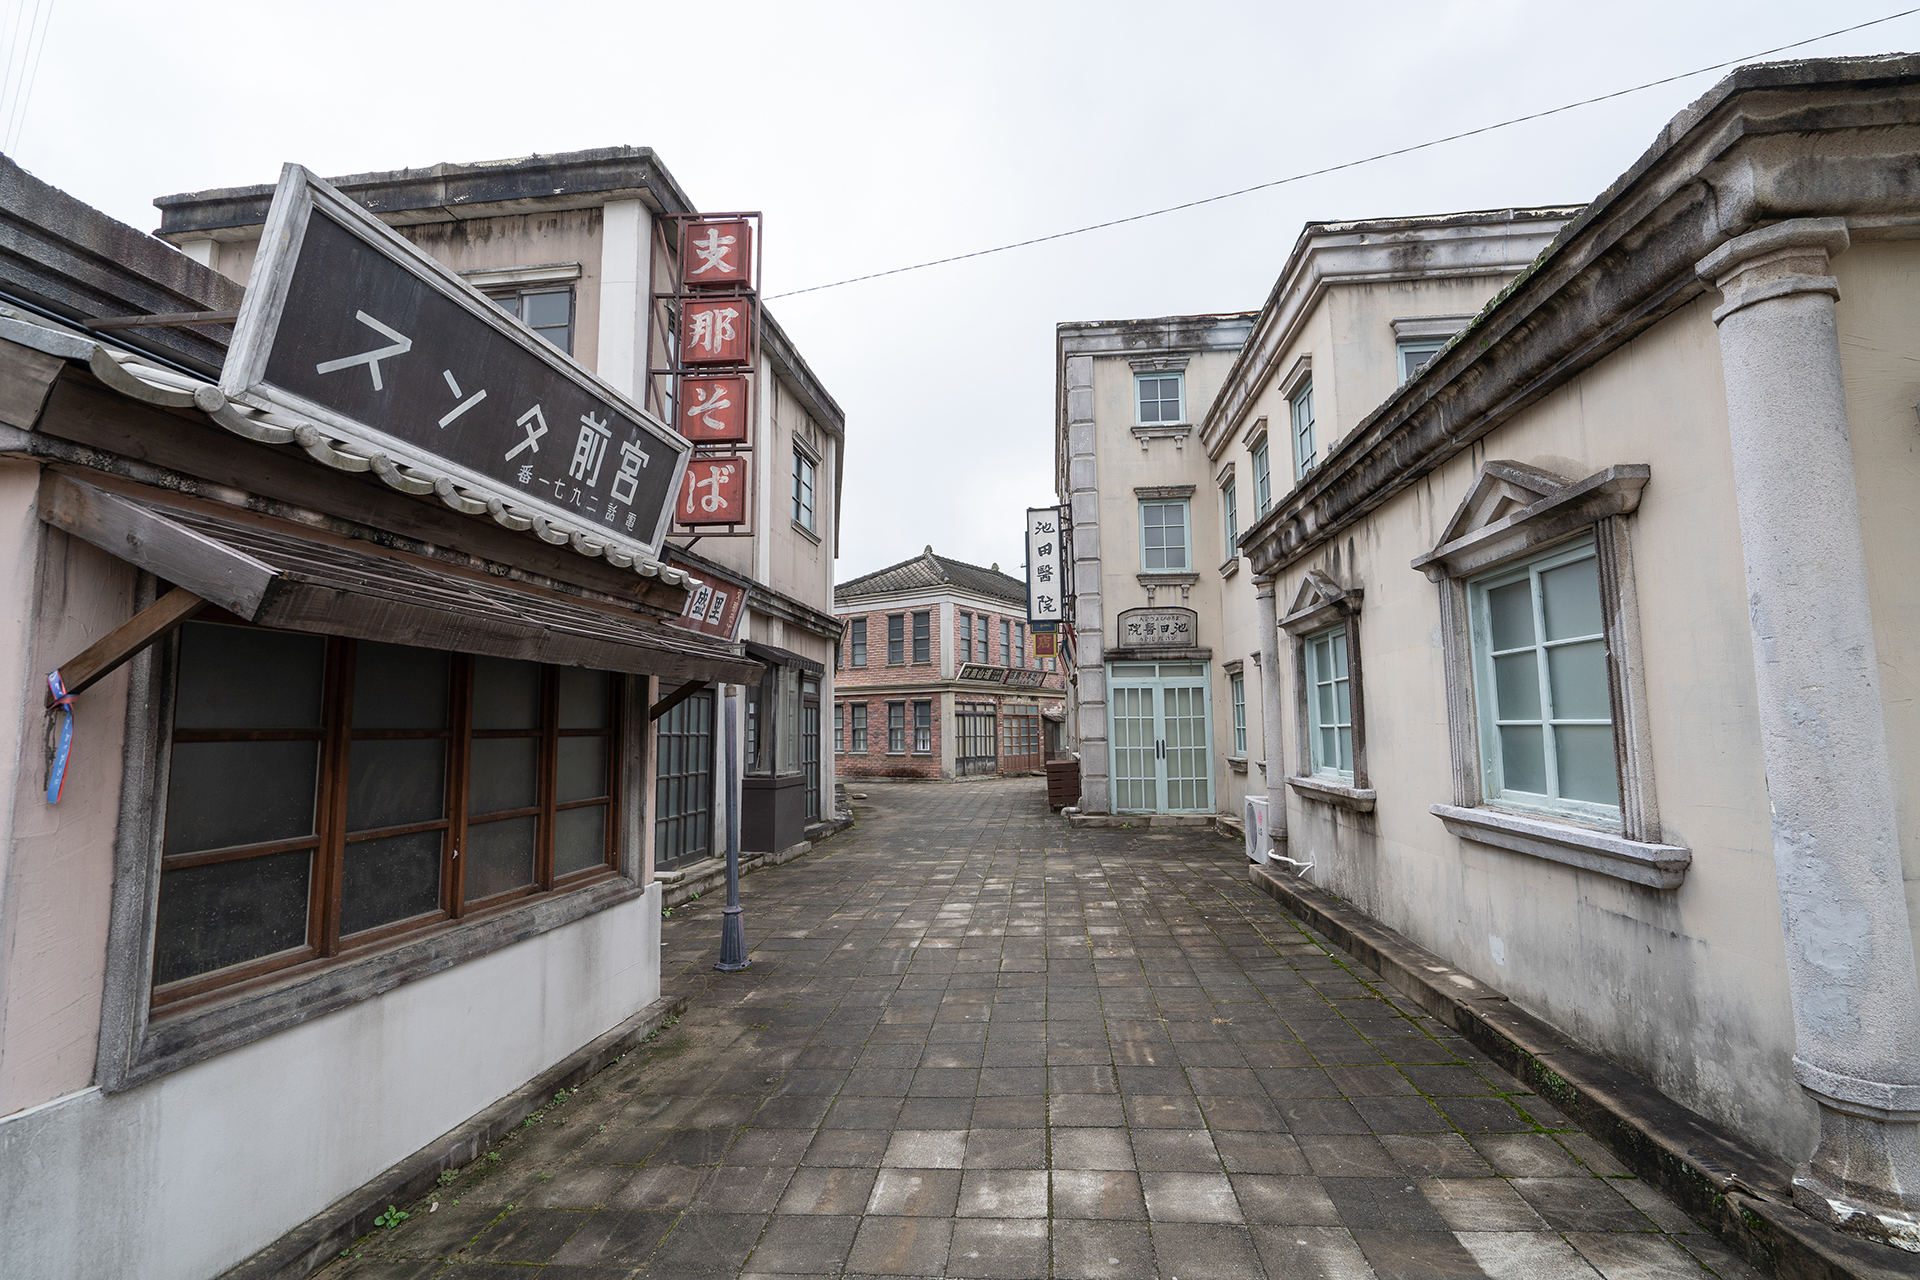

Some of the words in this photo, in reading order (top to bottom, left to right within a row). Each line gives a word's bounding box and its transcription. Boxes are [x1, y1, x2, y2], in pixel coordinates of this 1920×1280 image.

[684, 228, 738, 514] 支那そば
[1034, 521, 1057, 614] 池田醫院
